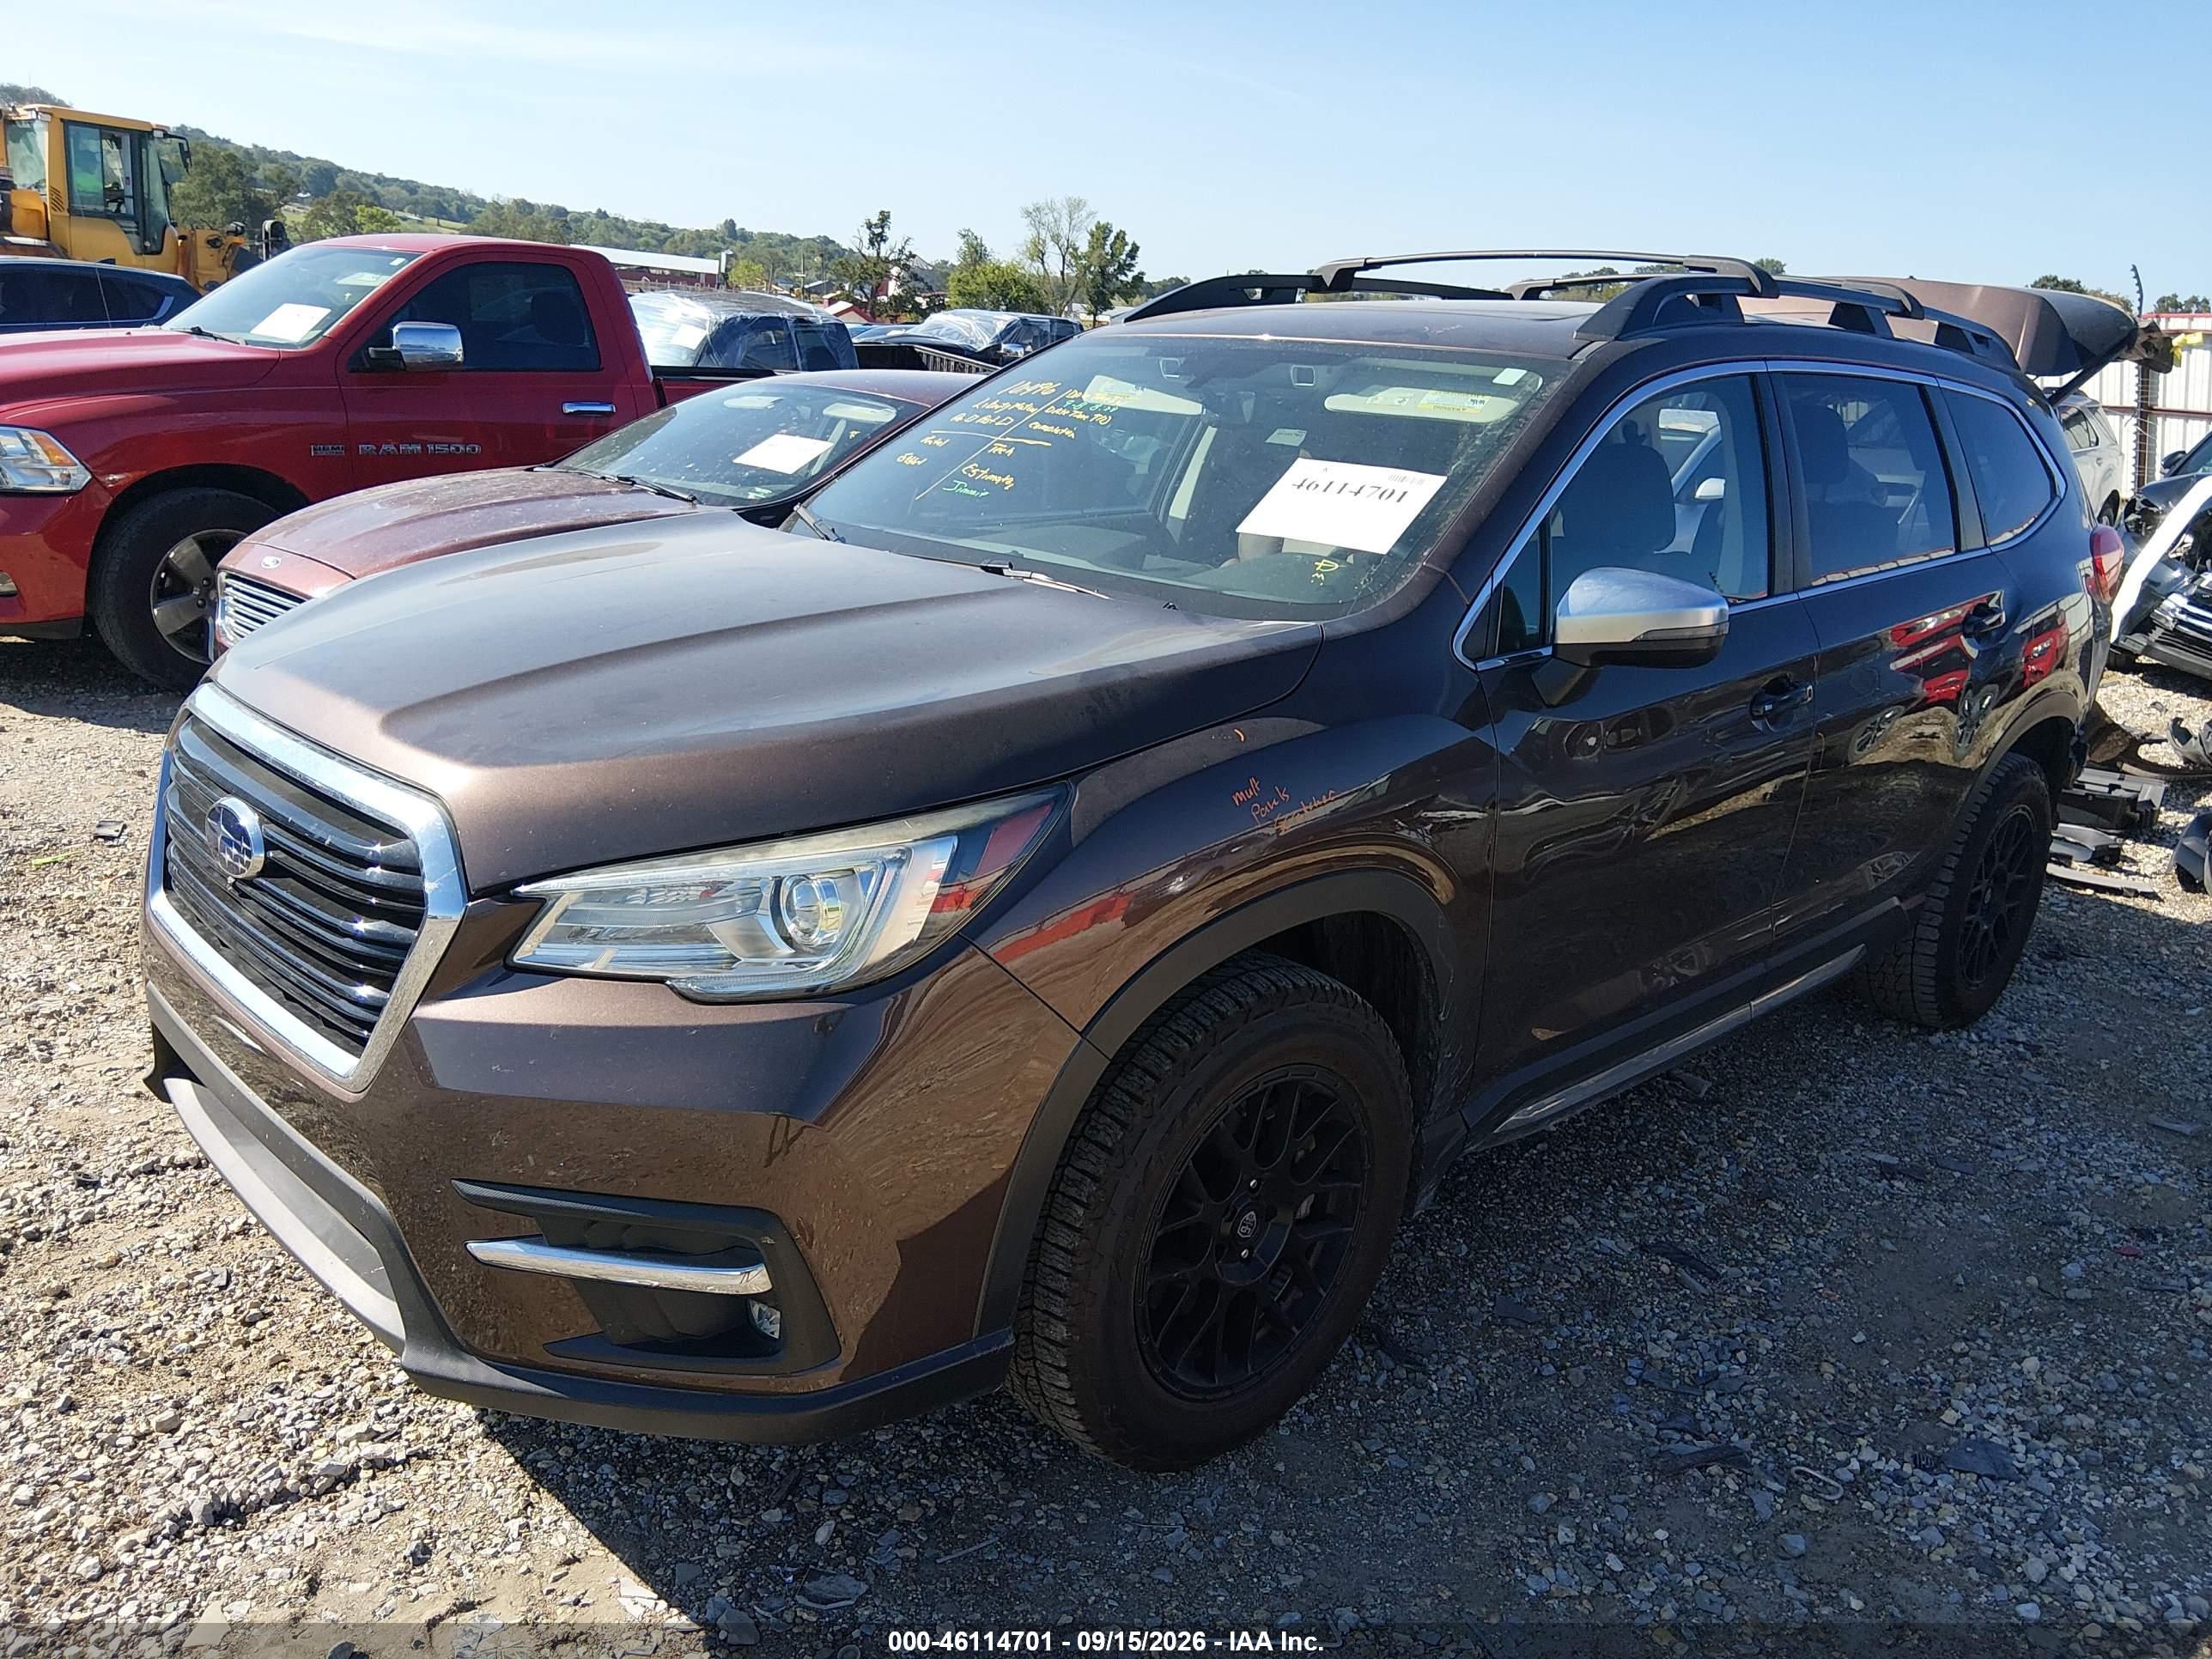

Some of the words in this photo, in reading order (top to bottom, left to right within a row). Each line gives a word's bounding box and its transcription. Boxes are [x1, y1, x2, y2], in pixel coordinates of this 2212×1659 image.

[358, 444, 422, 455] RAM
[427, 443, 481, 454] 1500
[1291, 477, 1409, 503] 46114701
